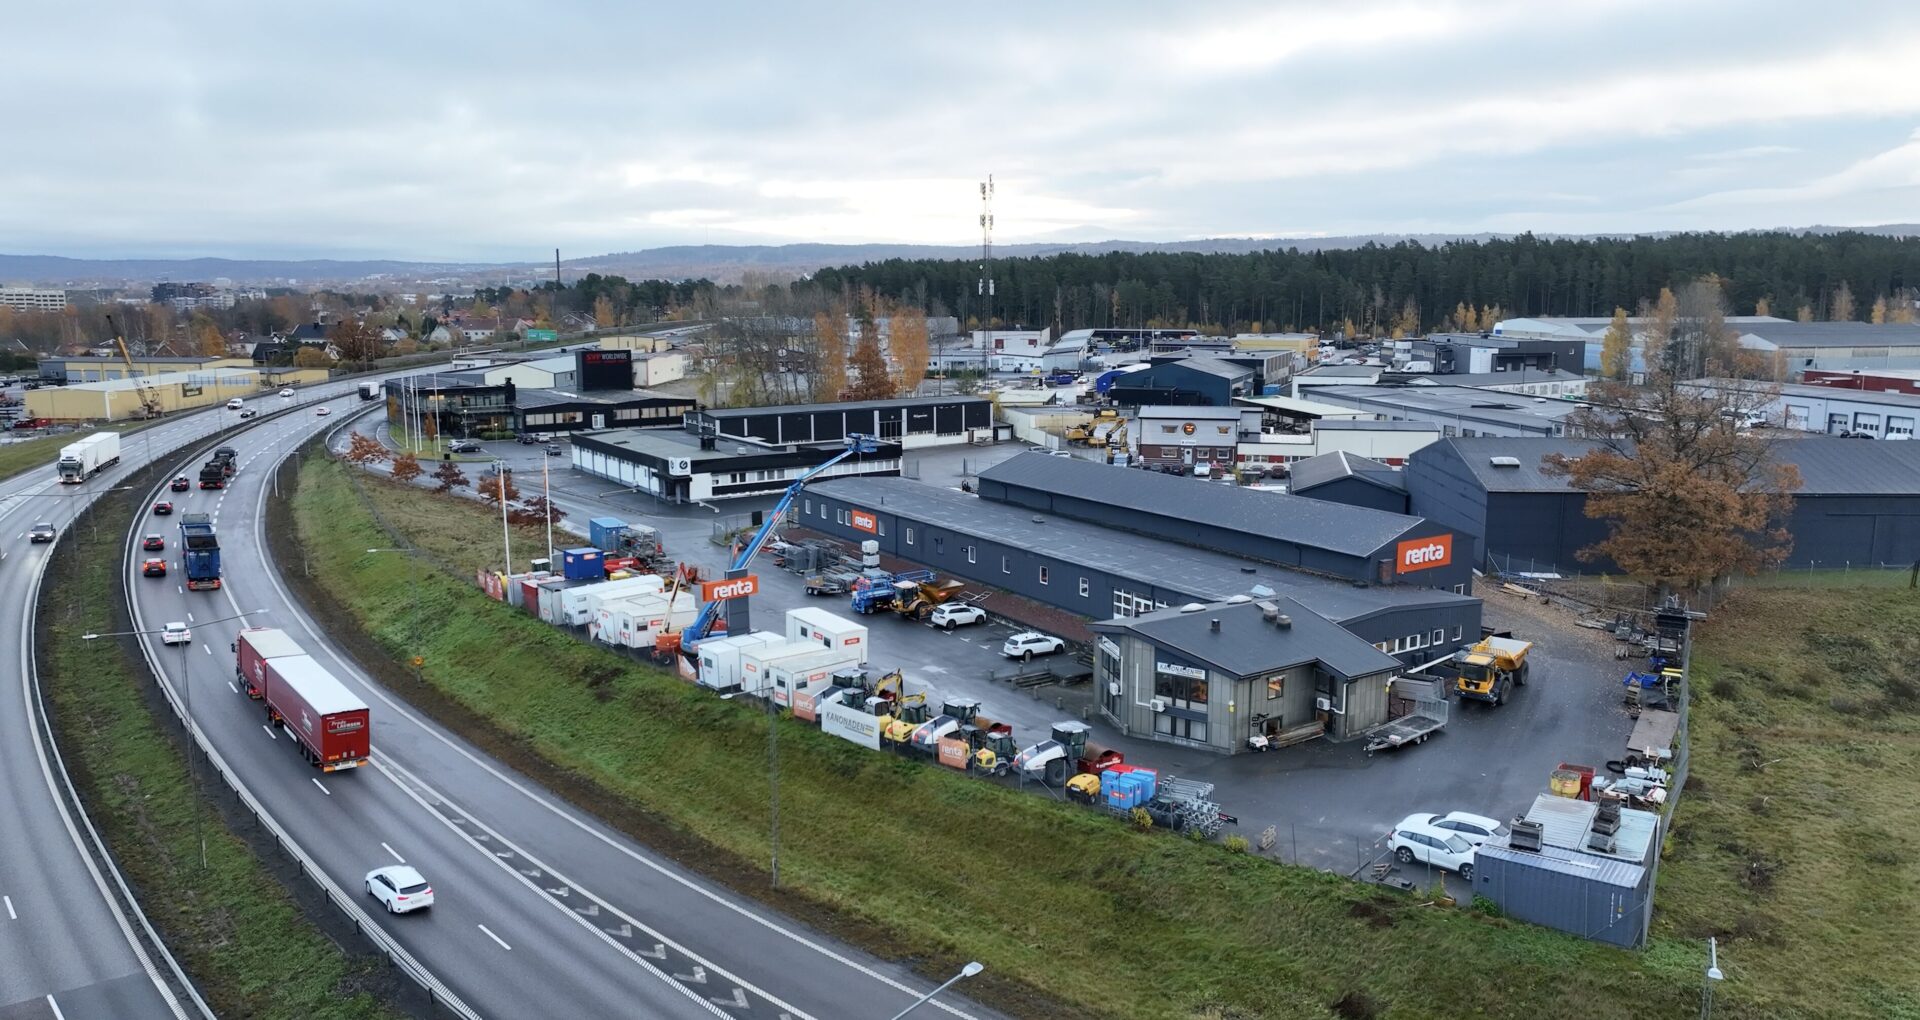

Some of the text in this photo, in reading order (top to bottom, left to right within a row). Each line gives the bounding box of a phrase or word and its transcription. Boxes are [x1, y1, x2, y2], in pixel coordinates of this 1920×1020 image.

[855, 516, 872, 529] renta
[1405, 543, 1444, 565] renta
[713, 580, 753, 599] renta
[826, 711, 865, 732] KANONADEN
[941, 744, 963, 757] renta
